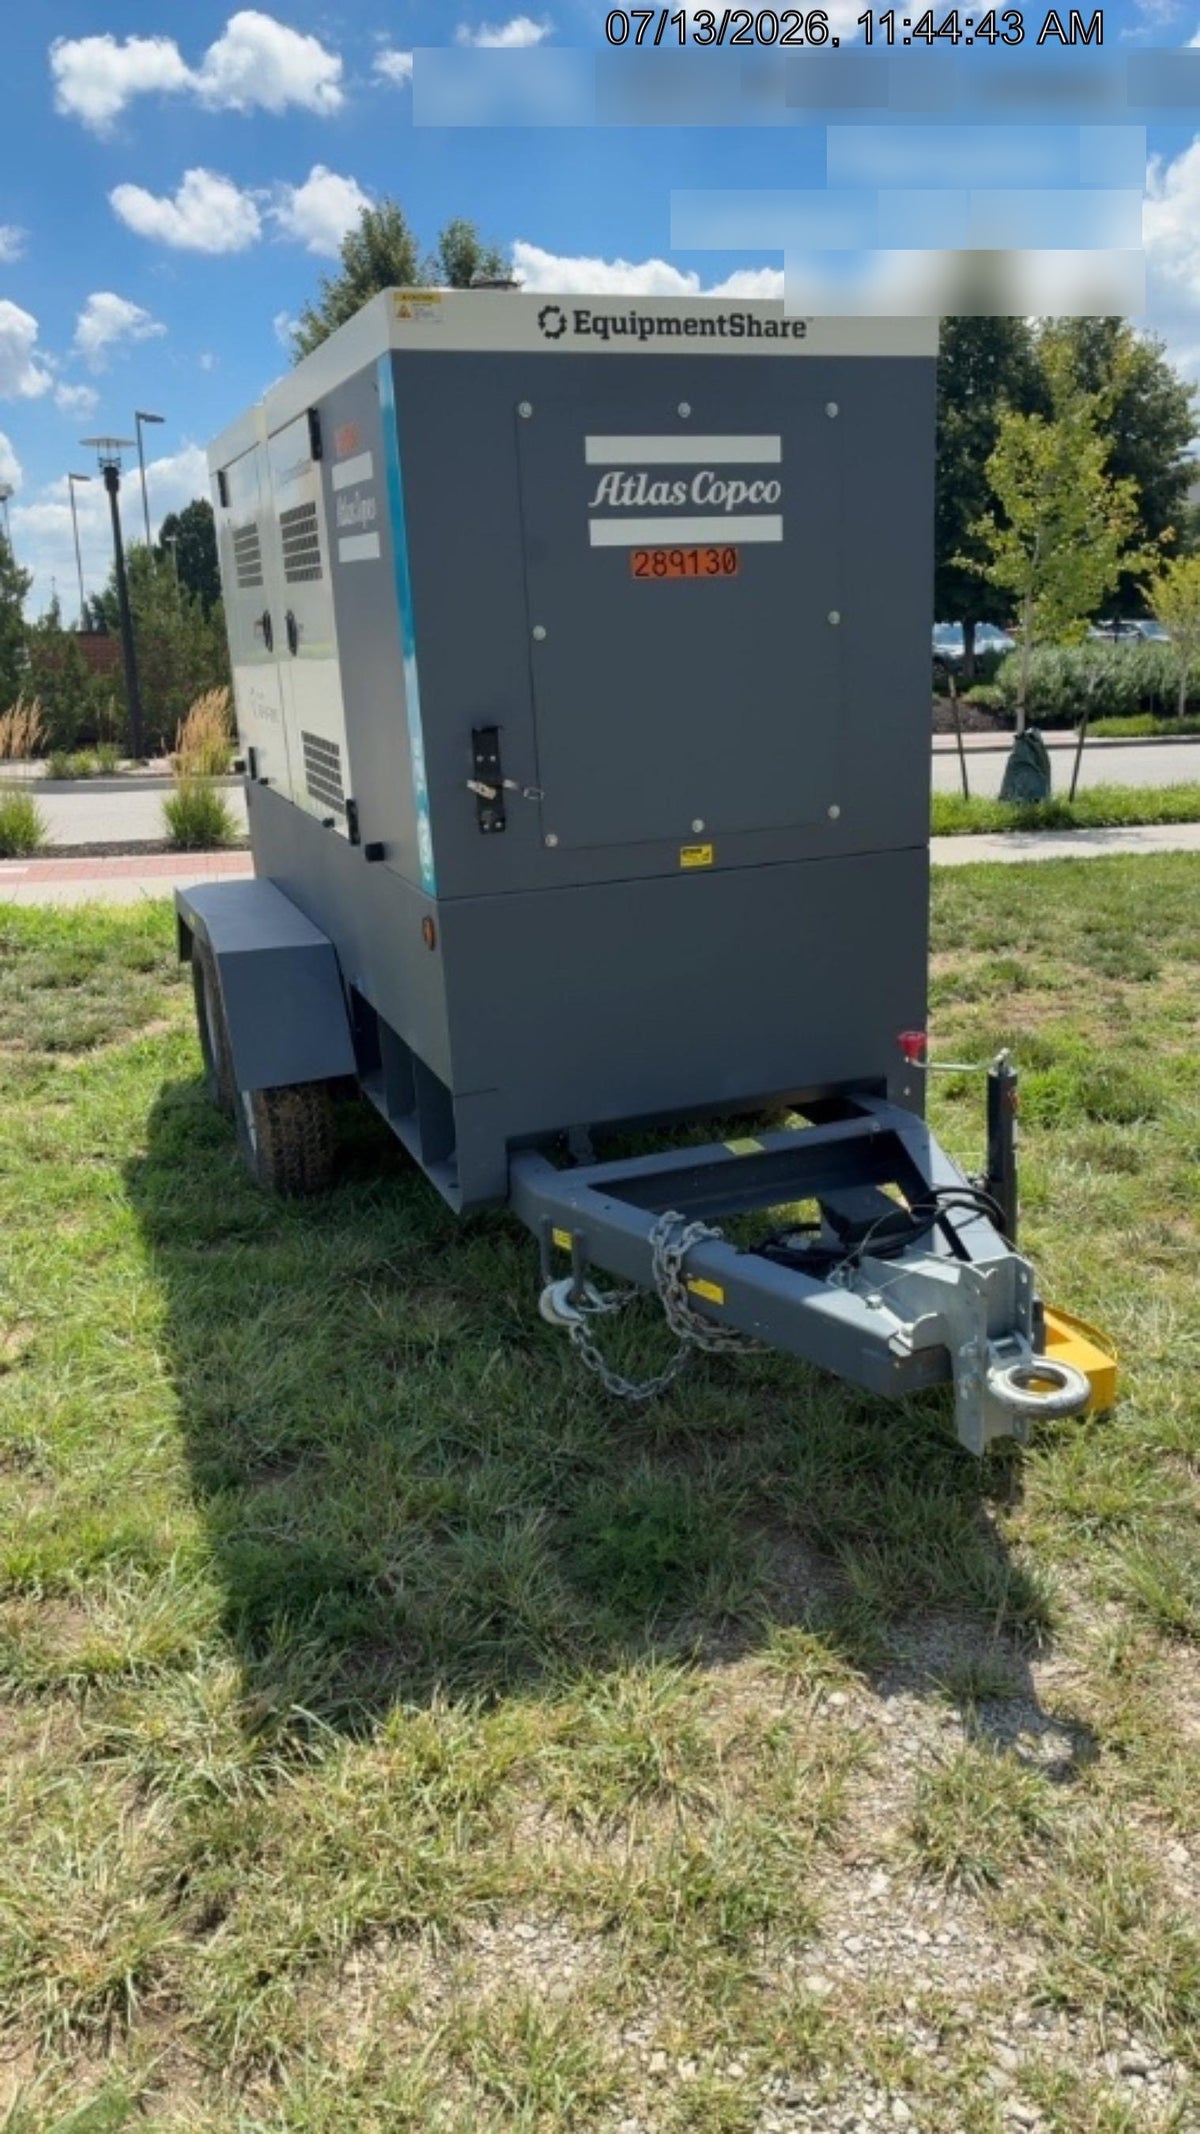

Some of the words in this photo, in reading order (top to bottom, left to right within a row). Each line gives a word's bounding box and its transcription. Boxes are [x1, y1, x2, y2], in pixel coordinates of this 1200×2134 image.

[573, 310, 808, 341] EquipmentShare
[588, 471, 688, 508] Atlas
[690, 471, 782, 512] Copco
[634, 547, 736, 577] 289130
